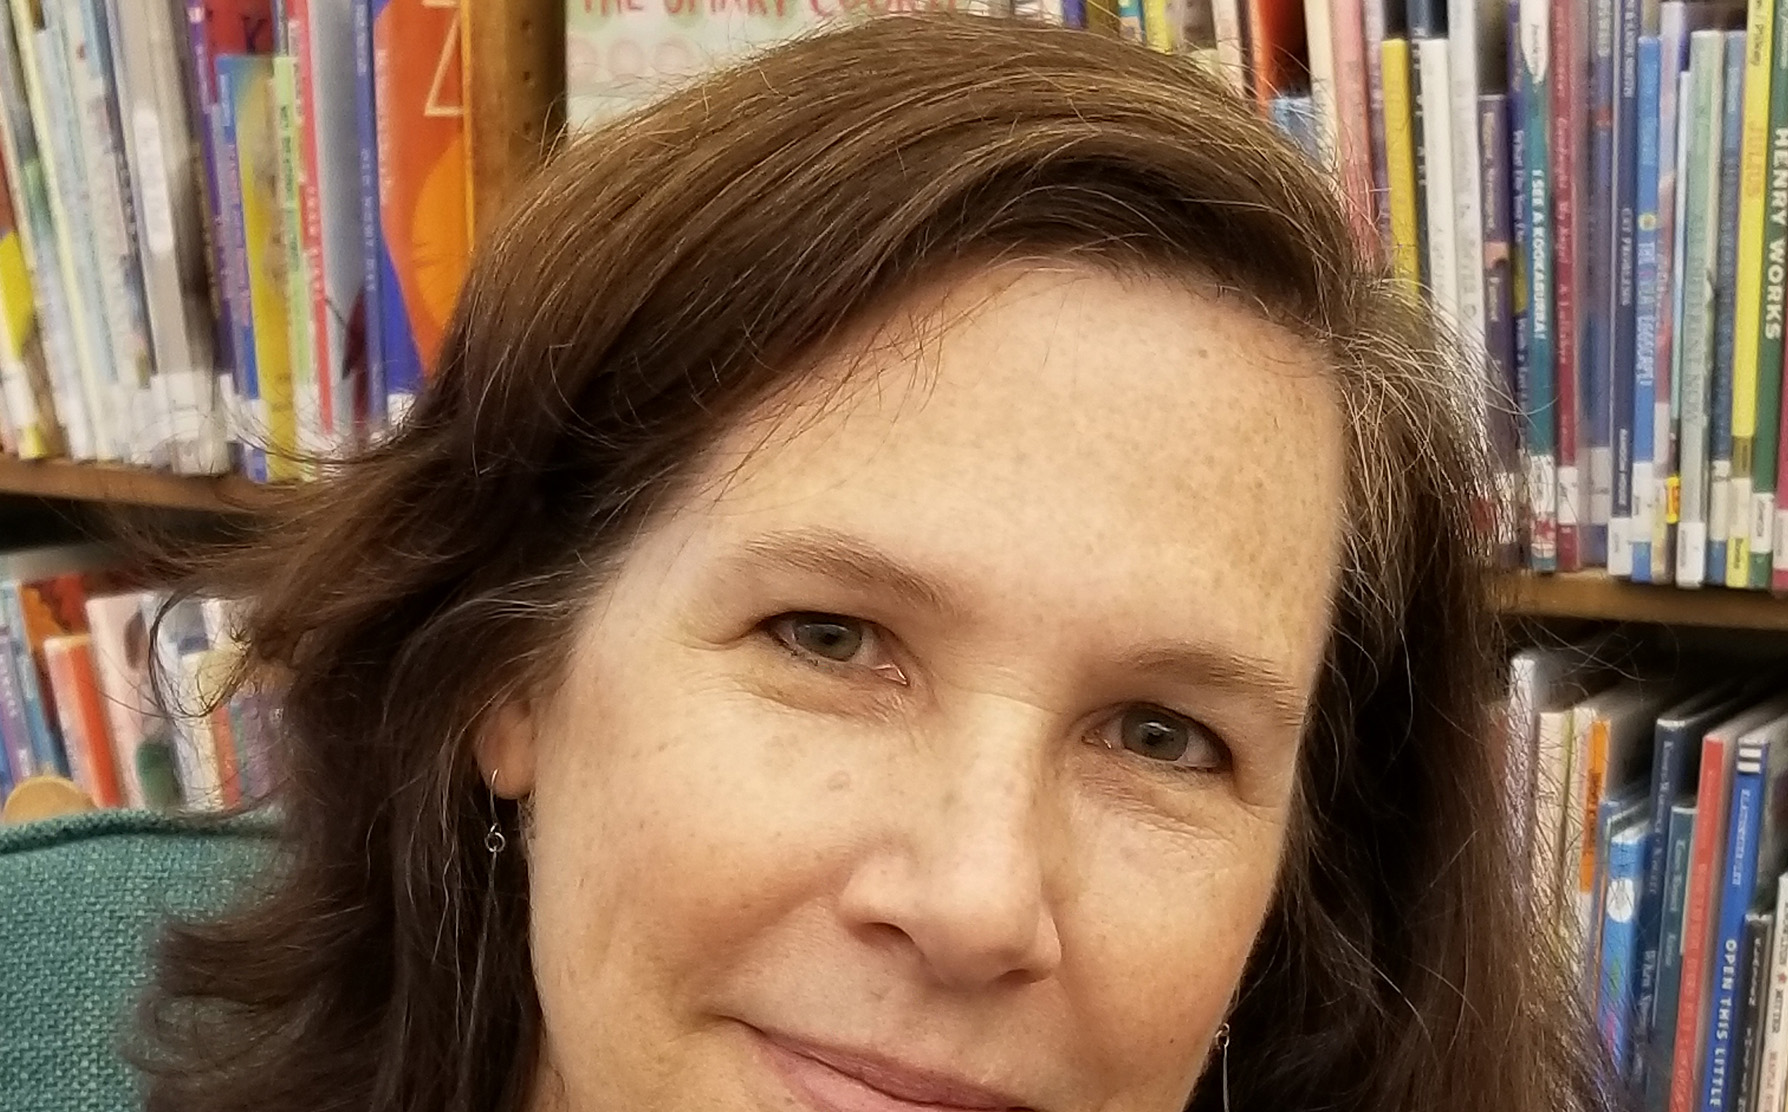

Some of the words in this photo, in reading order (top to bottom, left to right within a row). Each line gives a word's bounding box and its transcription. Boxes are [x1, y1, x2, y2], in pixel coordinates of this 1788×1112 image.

[1532, 168, 1546, 177] I
[1532, 178, 1546, 206] SEE
[1771, 126, 1788, 225] HENRY
[1532, 210, 1546, 223] A
[1532, 225, 1547, 341] KOOKABURRA!
[1765, 237, 1786, 339] WORKS
[1721, 937, 1738, 990] OPEN
[1716, 996, 1733, 1041] THIS
[1708, 1046, 1727, 1107] LITTLE
